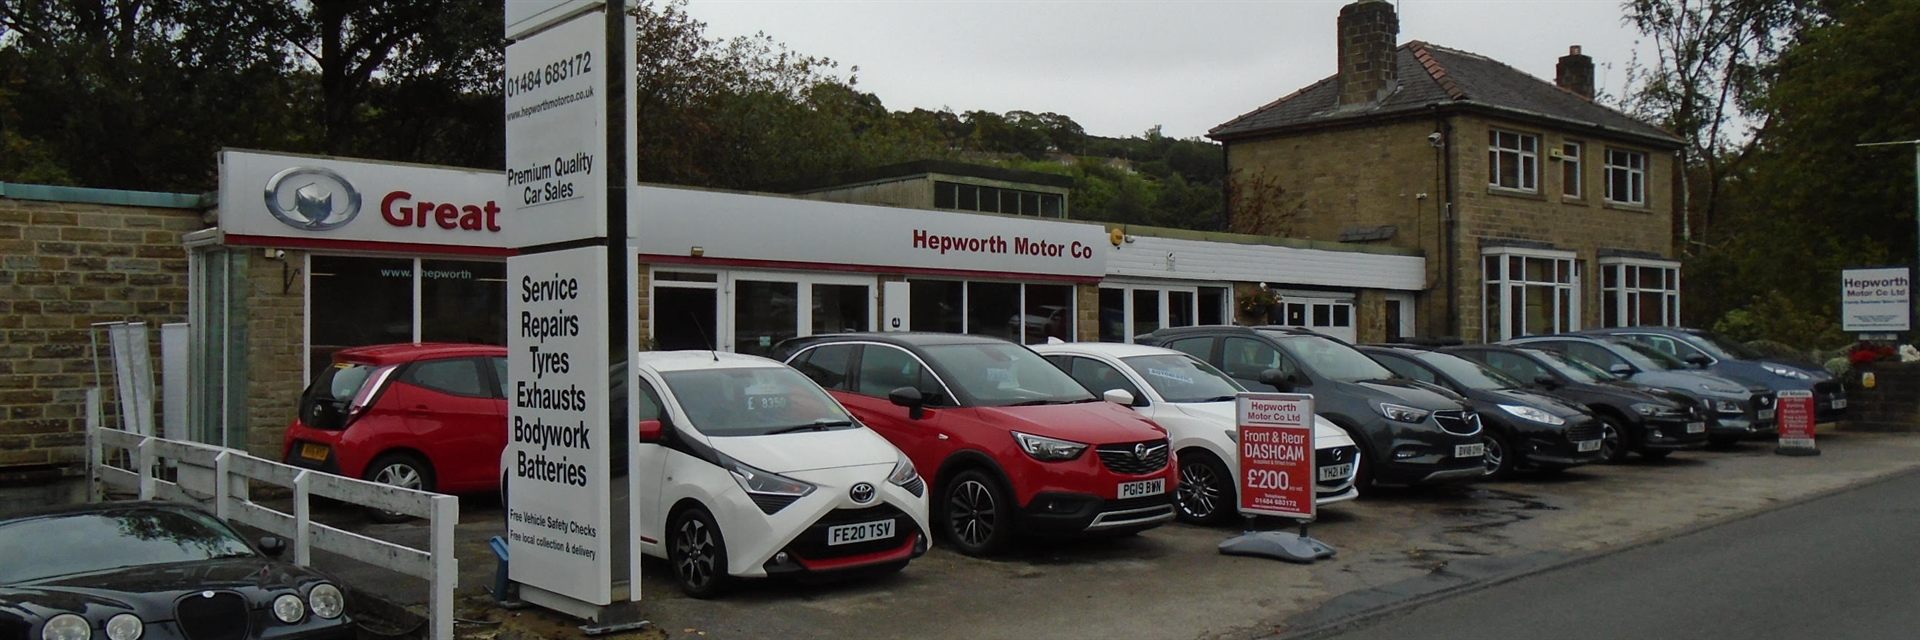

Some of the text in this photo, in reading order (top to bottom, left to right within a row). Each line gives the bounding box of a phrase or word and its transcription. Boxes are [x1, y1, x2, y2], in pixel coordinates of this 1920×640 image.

[507, 51, 591, 98] 01484 683172
[507, 85, 594, 121] www.hepworthmotorco.co.uk
[508, 152, 593, 187] Premium Quality
[524, 181, 573, 205] Car Sales
[381, 191, 501, 232] Great
[913, 229, 1092, 259] Hepworth Motor Co
[522, 273, 578, 302] Service
[1844, 277, 1908, 289] Hepworth
[1847, 289, 1873, 297] Motor
[522, 309, 579, 343] Repairs
[530, 346, 569, 379] Tyres
[517, 381, 586, 412] Exhausts
[1251, 401, 1297, 412] Hepworth
[1248, 412, 1300, 422] Motor Co Ltd
[514, 416, 590, 451] Bodywork
[1244, 430, 1305, 444] Front & Rear
[1244, 443, 1304, 461] DASHCAM
[518, 450, 587, 487] Batteries
[1248, 469, 1289, 490] £200
[1123, 480, 1162, 496] PG19 BWN
[510, 508, 596, 537] Free Vehicle Safety Checks
[834, 521, 890, 542] FE20 TSV
[510, 529, 596, 561] Free local collection & delivery
